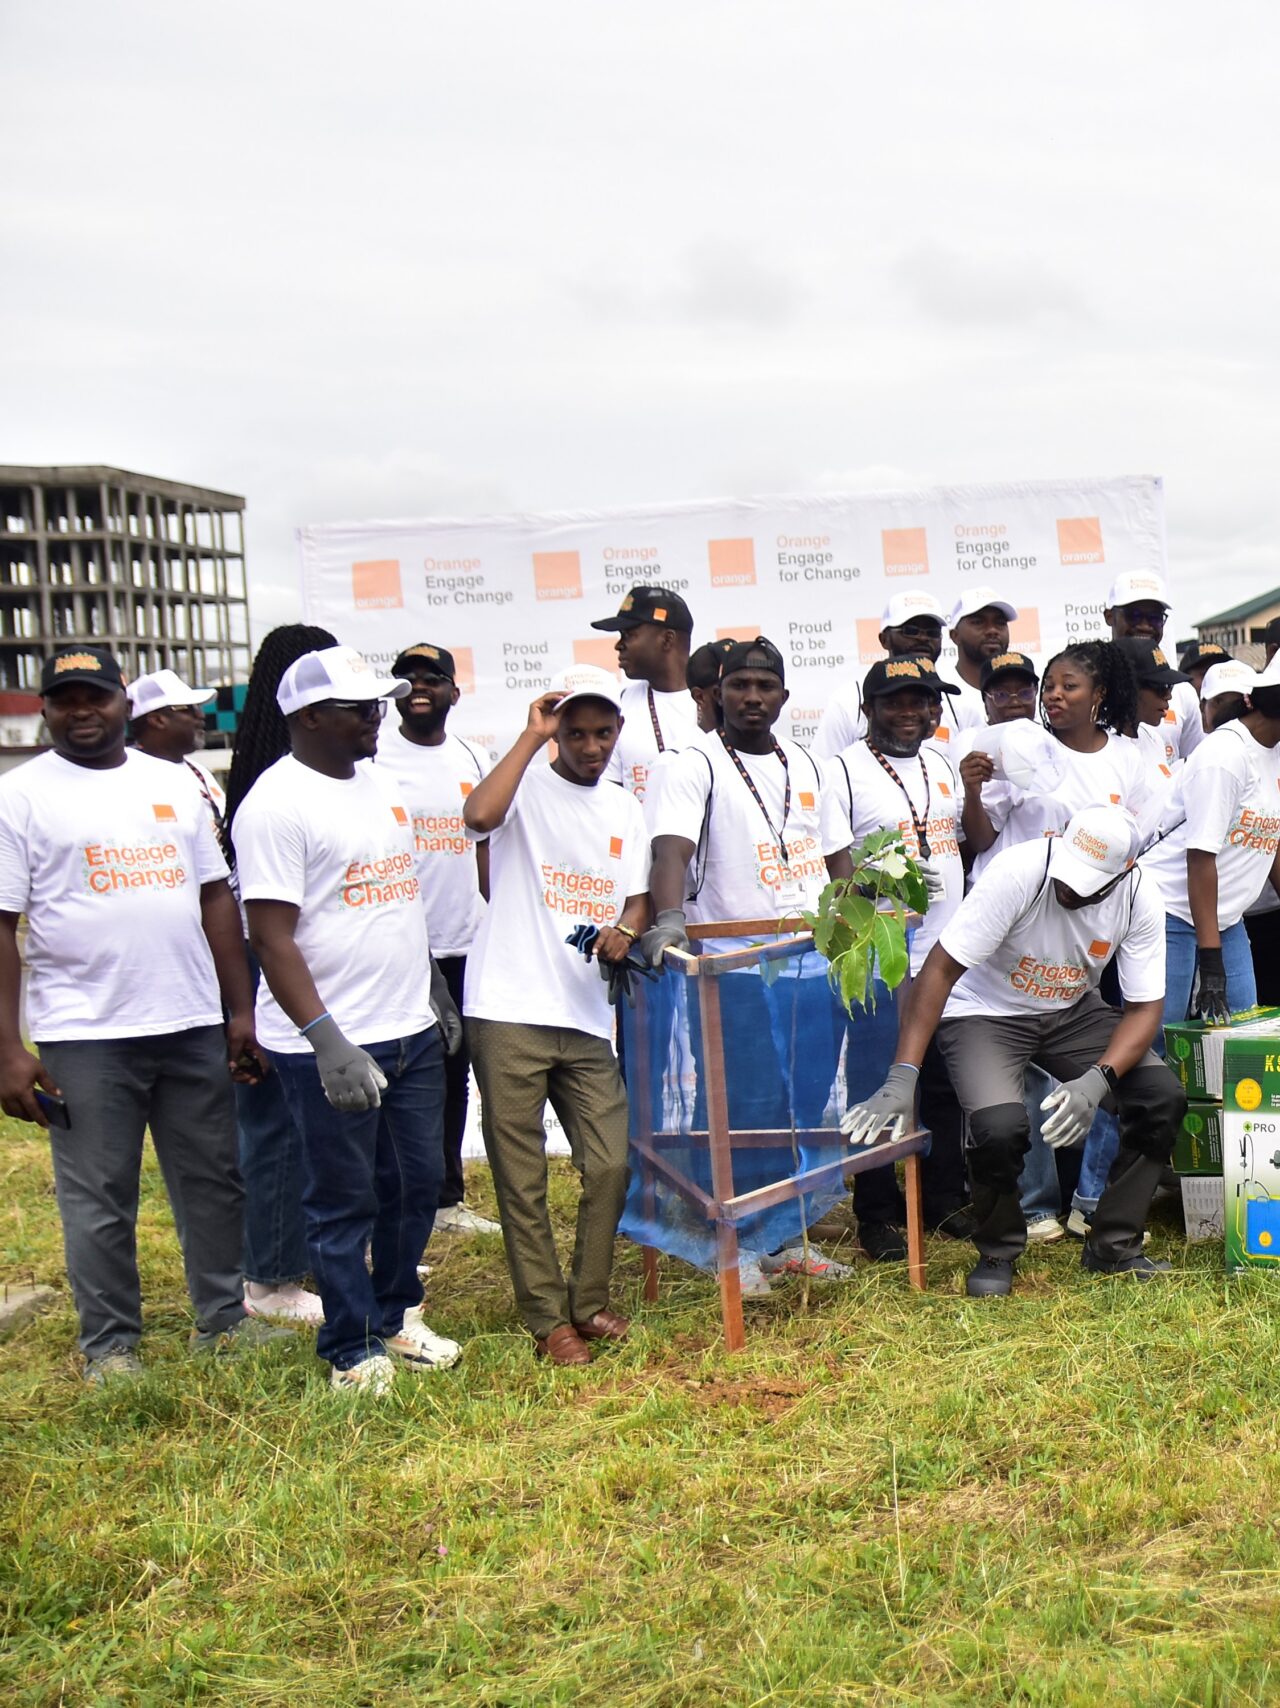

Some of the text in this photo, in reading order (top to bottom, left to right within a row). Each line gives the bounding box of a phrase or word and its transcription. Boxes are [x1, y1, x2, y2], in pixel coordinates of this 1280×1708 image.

[955, 524, 1007, 538] Orange
[777, 535, 830, 549] Orange
[956, 540, 1010, 556] Engage
[603, 547, 658, 561] Orange
[778, 552, 833, 567] Engage
[1062, 551, 1100, 563] orange
[424, 557, 481, 573] Orange
[886, 563, 924, 574] orange
[957, 555, 1037, 571] for Change
[605, 564, 661, 579] Engage
[779, 567, 861, 582] for Change
[425, 574, 484, 591] Engage
[712, 574, 752, 585] orange
[537, 586, 579, 599] orange
[606, 581, 626, 595] for
[427, 590, 513, 606] for Change
[1065, 602, 1107, 616] Proud
[789, 620, 832, 634] Proud
[1066, 619, 1101, 633] to be
[503, 641, 549, 656] Proud
[789, 637, 826, 651] to be
[504, 658, 542, 672] to be
[791, 654, 845, 668] Orange
[505, 676, 551, 690] Orang
[412, 815, 466, 833] ngag
[415, 835, 474, 855] hange
[1077, 828, 1108, 851] Engage
[84, 844, 177, 867] Engage
[1073, 837, 1106, 861] Change
[345, 853, 412, 882] Engage
[88, 867, 187, 894] Change
[542, 864, 614, 896] Engage
[343, 877, 420, 907] Change
[544, 889, 616, 924] Change
[1018, 956, 1088, 982] Engage
[1010, 972, 1088, 1000] Change
[1265, 1055, 1275, 1072] K
[1253, 1123, 1276, 1133] PRO
